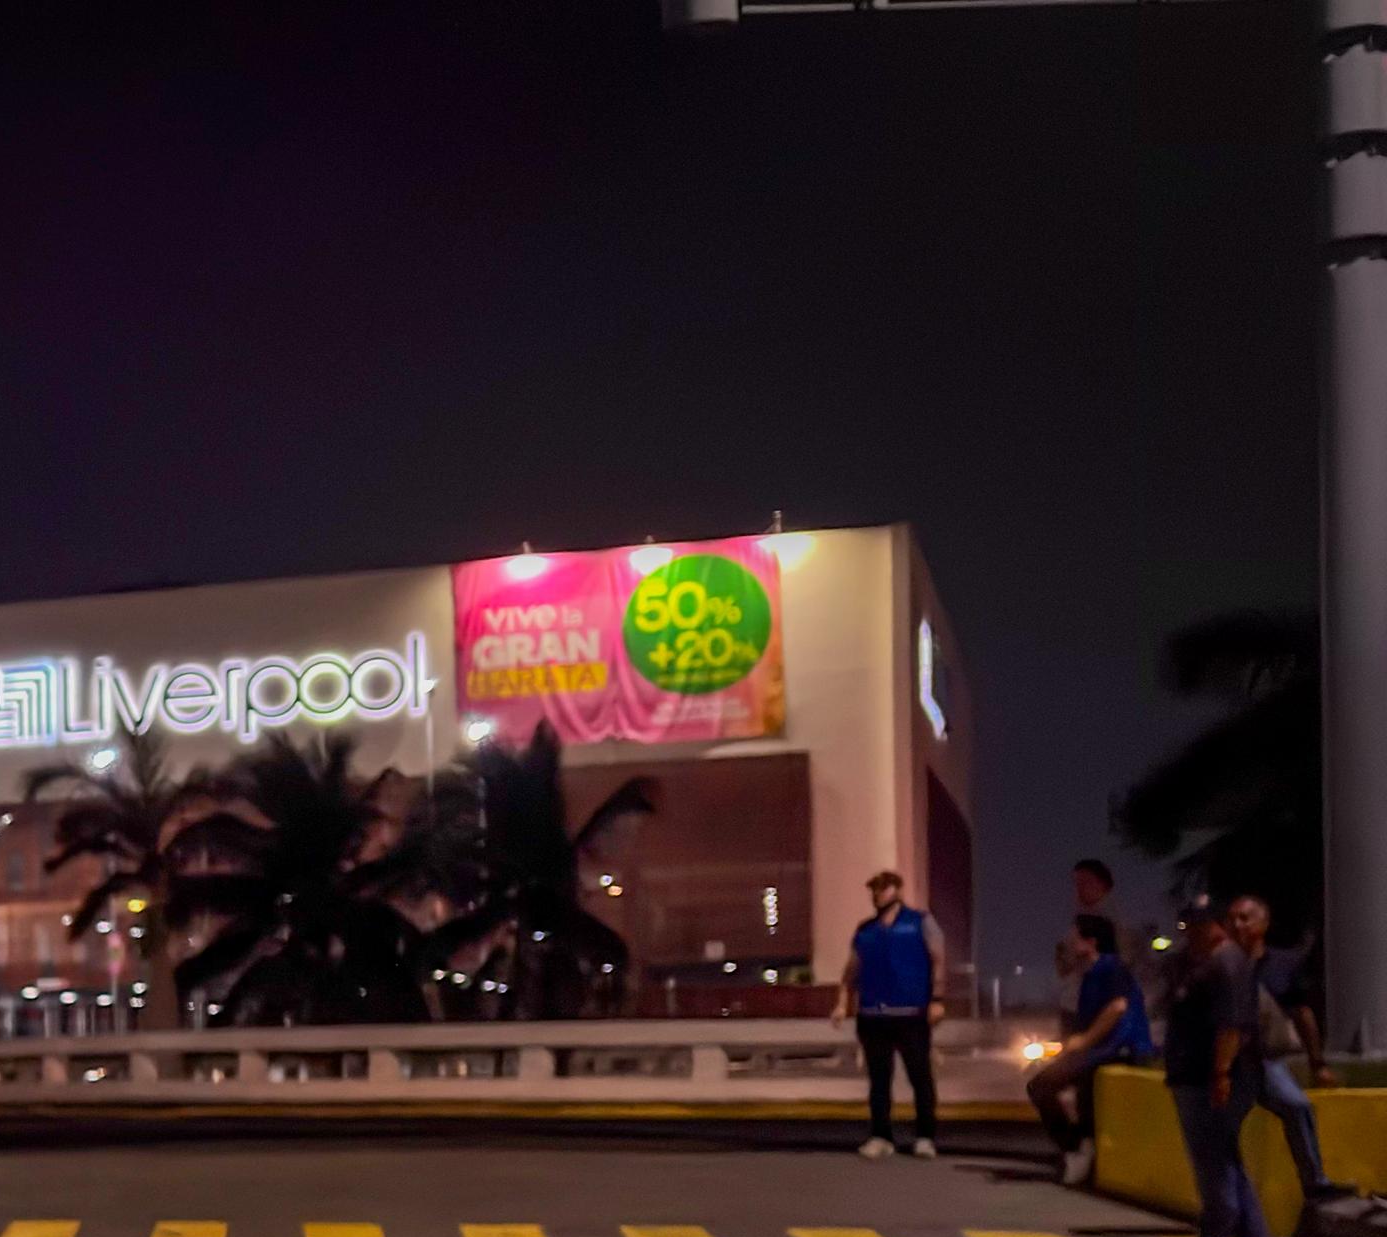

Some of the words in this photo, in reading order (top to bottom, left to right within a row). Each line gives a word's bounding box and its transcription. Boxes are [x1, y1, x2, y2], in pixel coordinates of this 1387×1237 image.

[635, 577, 742, 632] 50%
[473, 629, 600, 670] GRAN
[59, 631, 426, 744] Liverpool
